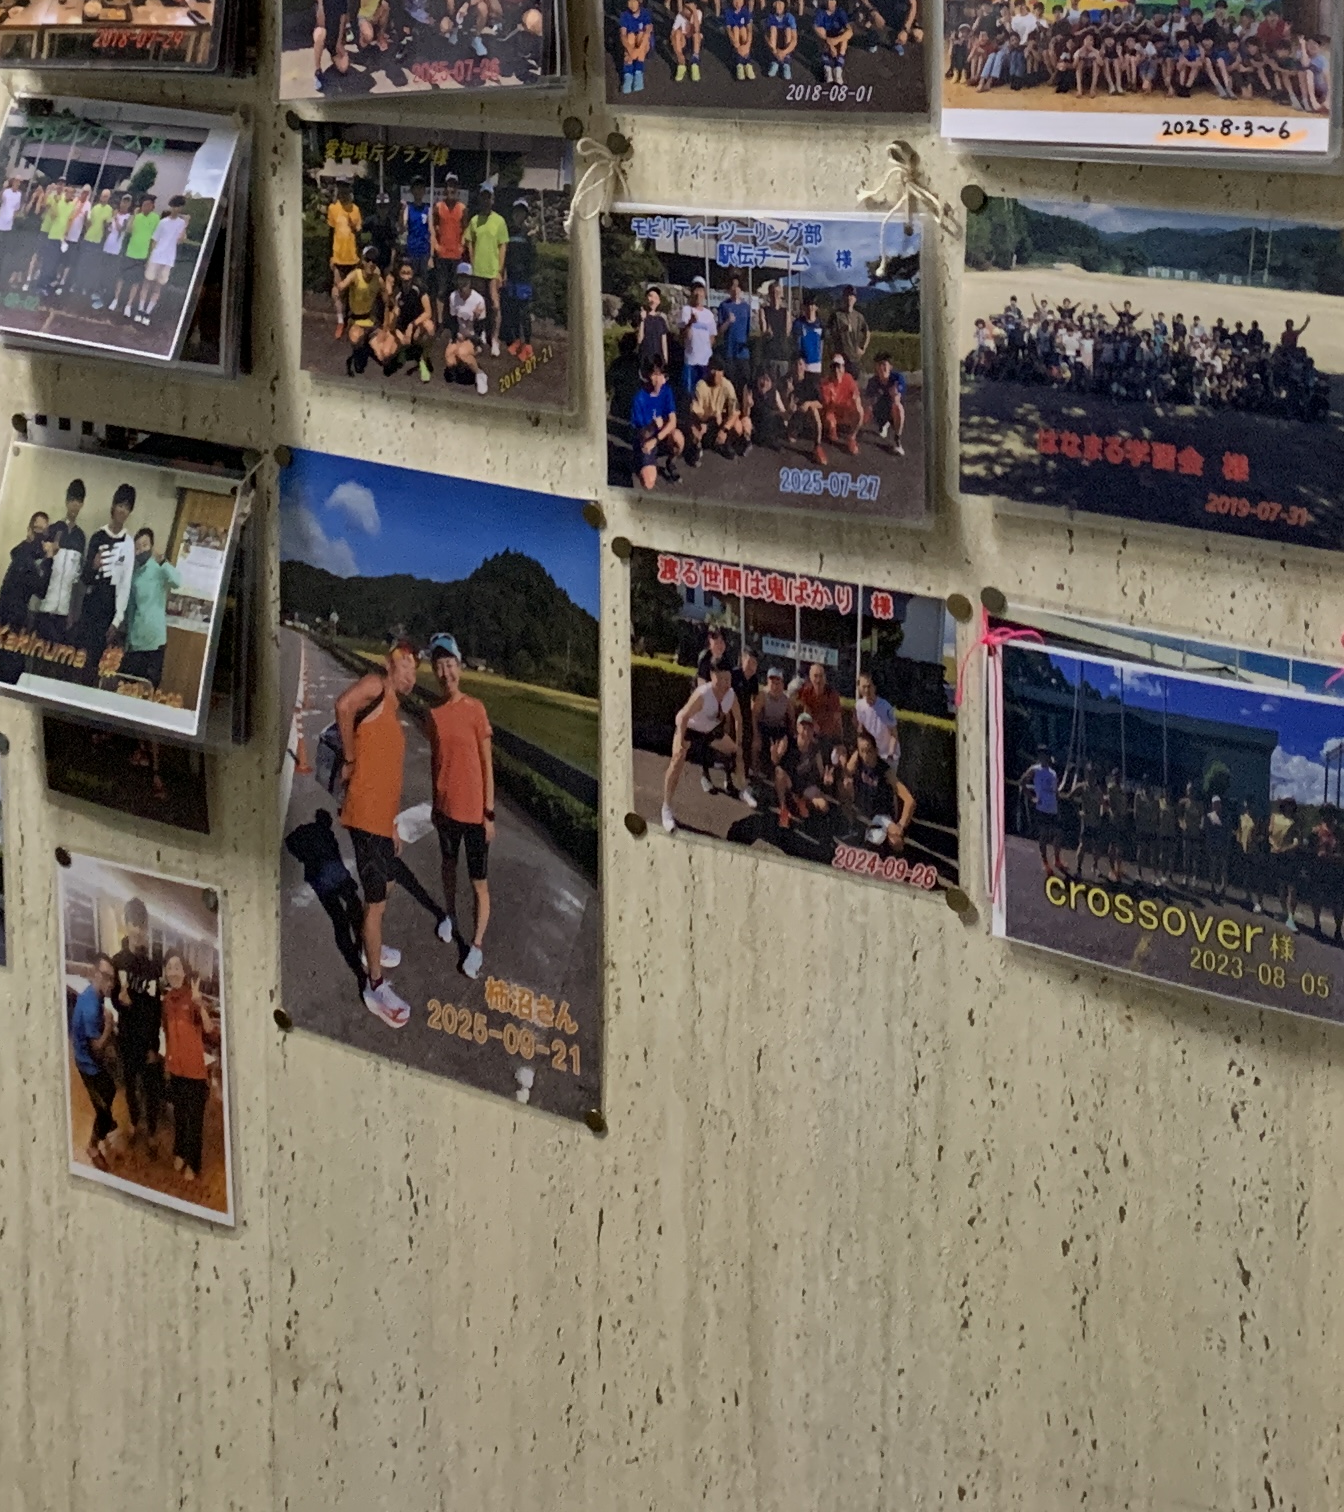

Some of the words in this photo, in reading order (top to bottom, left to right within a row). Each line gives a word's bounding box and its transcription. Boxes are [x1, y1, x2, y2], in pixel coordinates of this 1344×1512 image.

[716, 243, 809, 269] 駅伝チーム
[835, 249, 853, 270] 様
[656, 554, 853, 615] 渡る世間は鬼ばかり
[871, 591, 894, 619] 様
[832, 844, 936, 888] 2024-09-26
[1045, 875, 1265, 954] crossover
[1269, 932, 1296, 964] 様
[1190, 947, 1330, 999] 2023-08-05
[427, 997, 582, 1075] 2025-09-21
